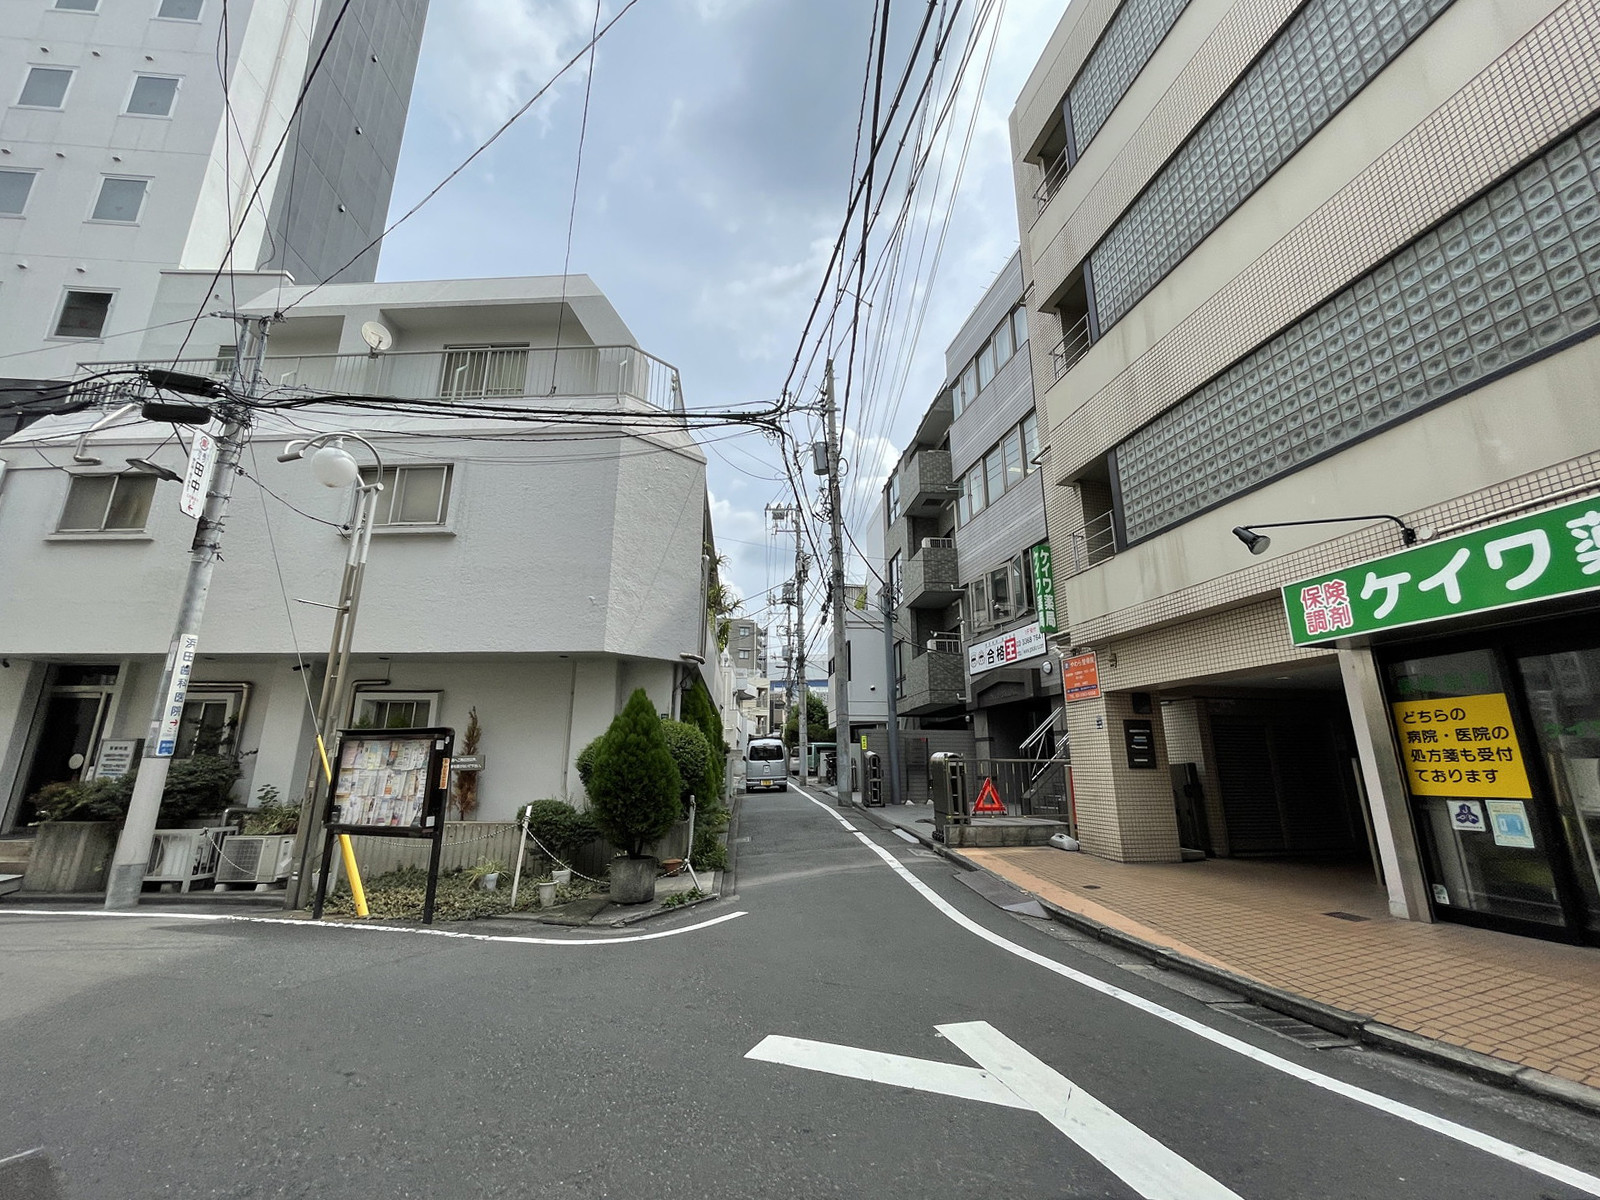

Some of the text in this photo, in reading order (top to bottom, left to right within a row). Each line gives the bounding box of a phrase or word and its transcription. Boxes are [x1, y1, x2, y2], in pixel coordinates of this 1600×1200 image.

[1040, 549, 1056, 627] ケイワ薬局
[1301, 580, 1348, 609] 保険
[1305, 604, 1353, 634] 調剤
[987, 638, 1017, 665] 合格王
[1402, 707, 1466, 724] どちらの
[1406, 726, 1509, 744] 病院・医院の
[1410, 746, 1513, 763] 処方箋も受付
[1414, 768, 1499, 784] ております
